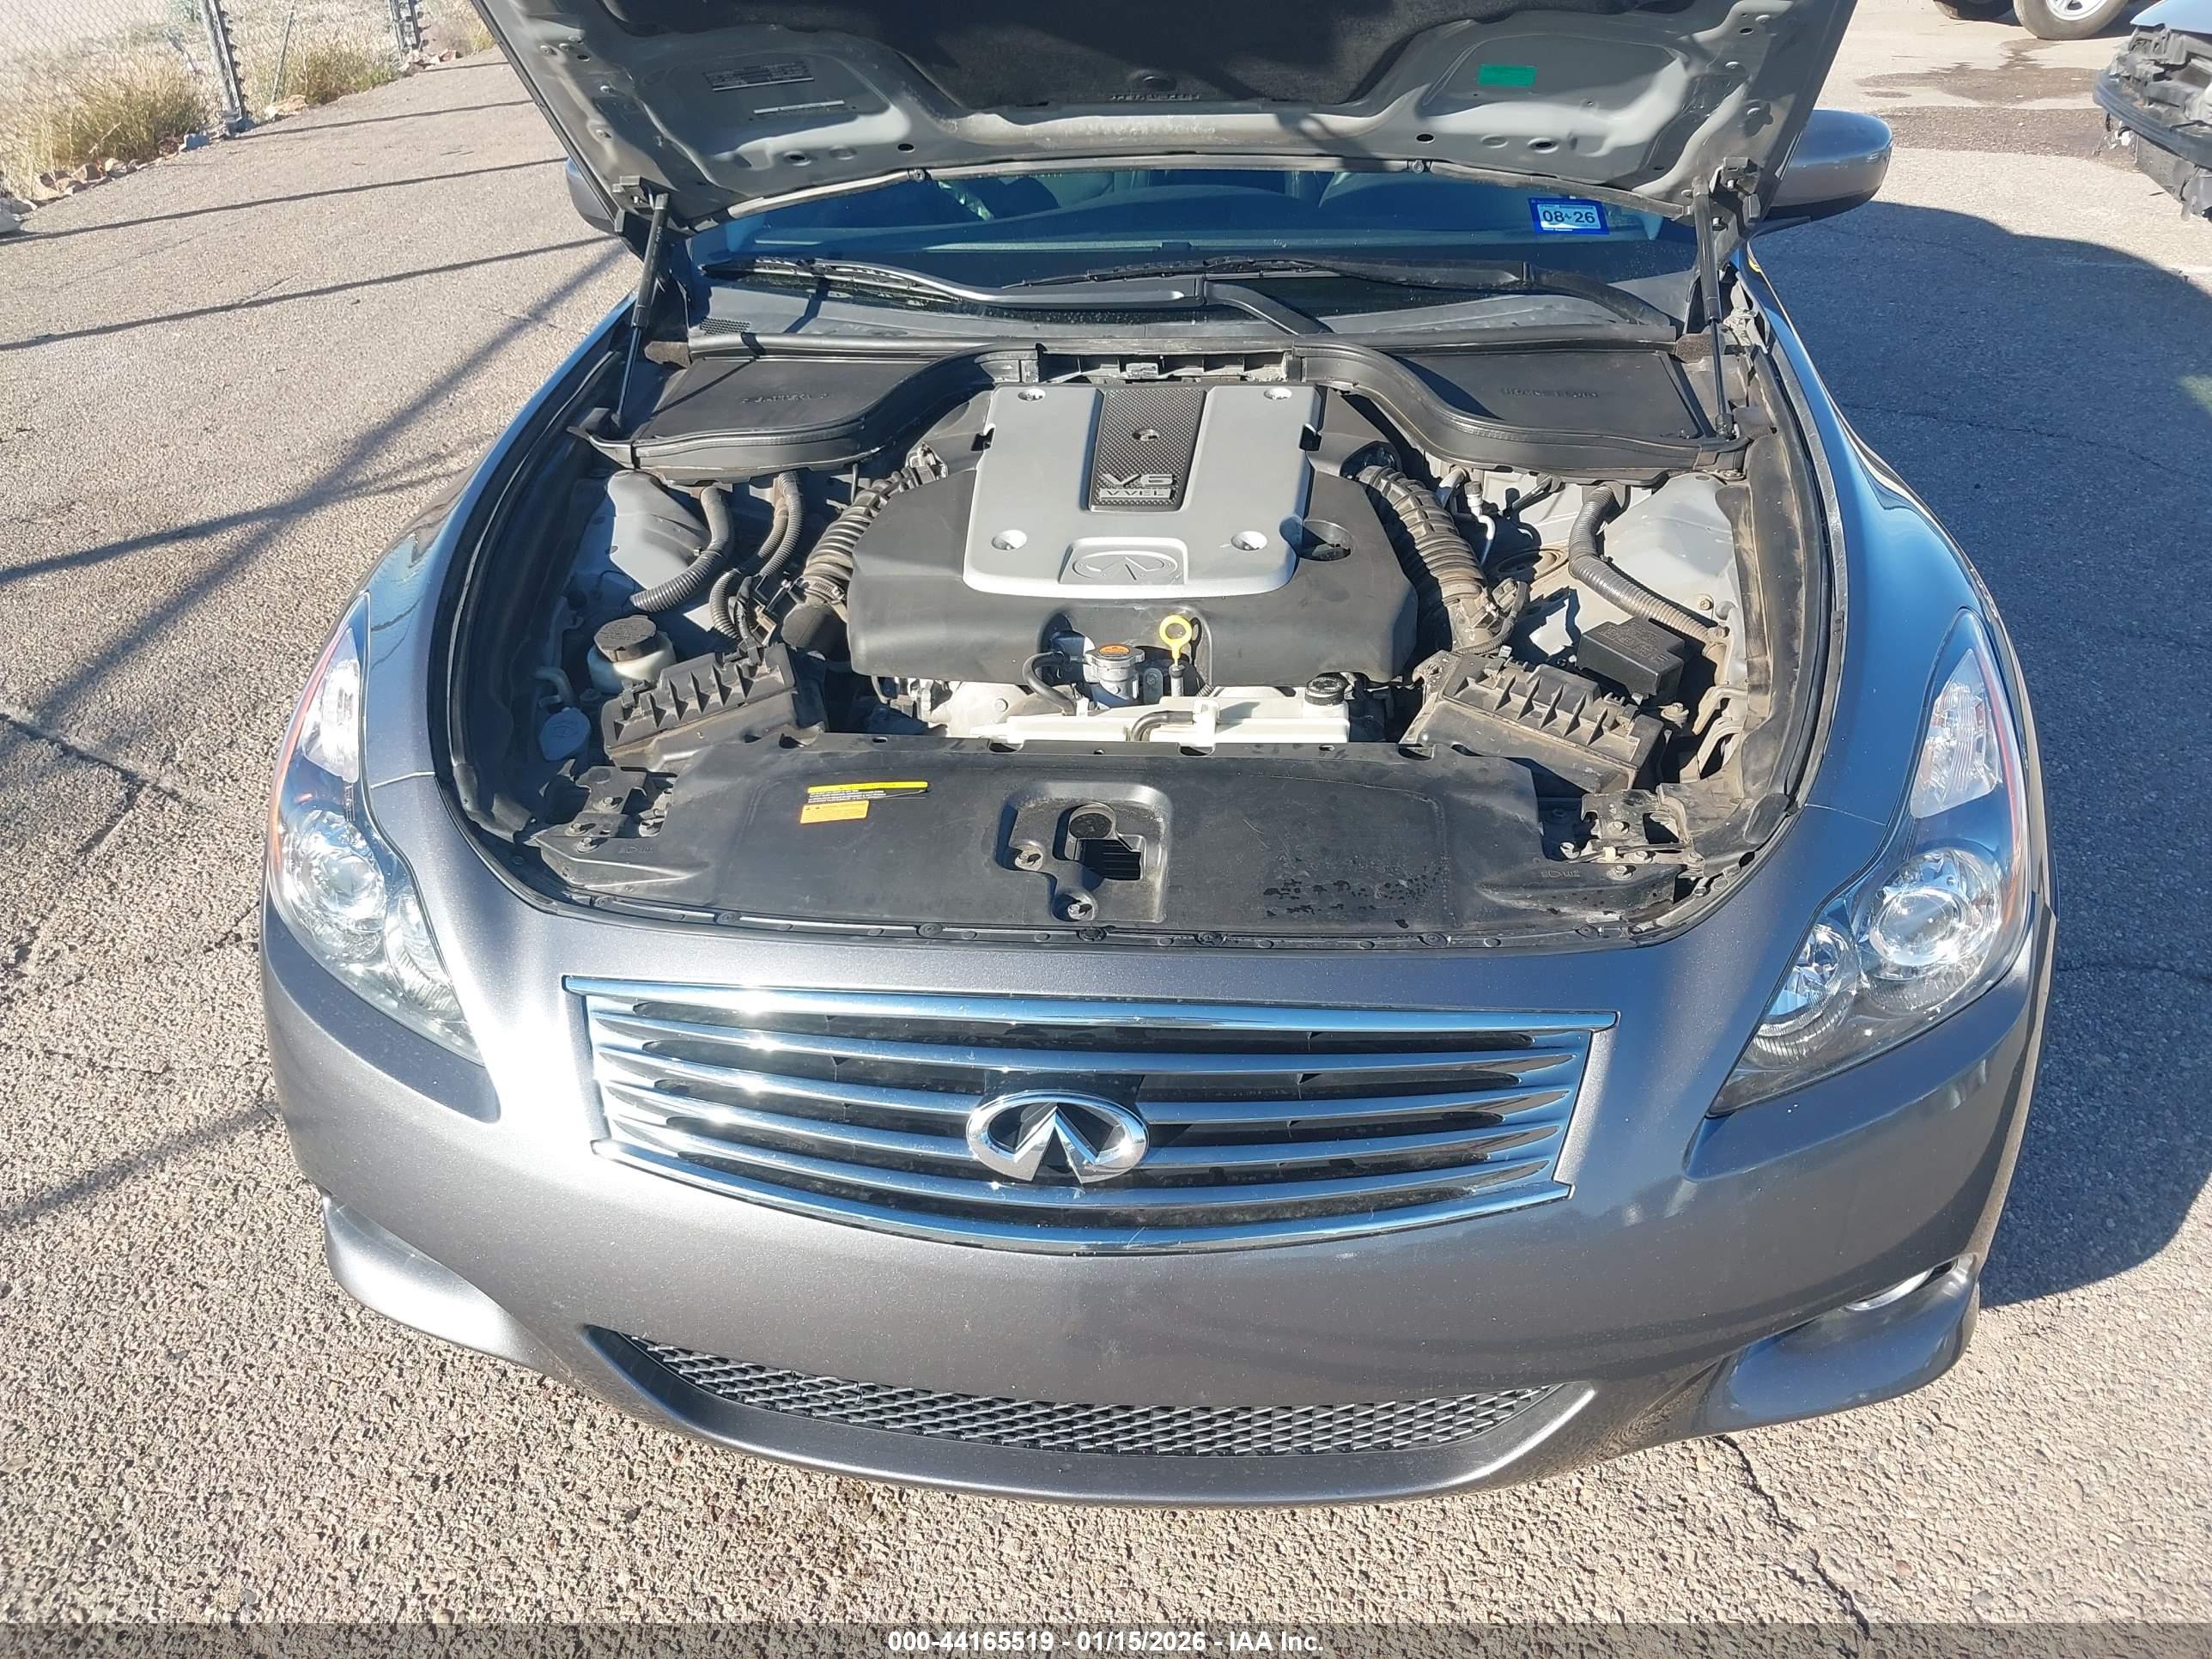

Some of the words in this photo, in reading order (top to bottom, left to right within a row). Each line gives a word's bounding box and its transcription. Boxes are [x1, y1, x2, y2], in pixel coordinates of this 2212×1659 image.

[1542, 210, 1565, 222] 08
[1573, 211, 1595, 223] 26
[1102, 473, 1173, 488] V6
